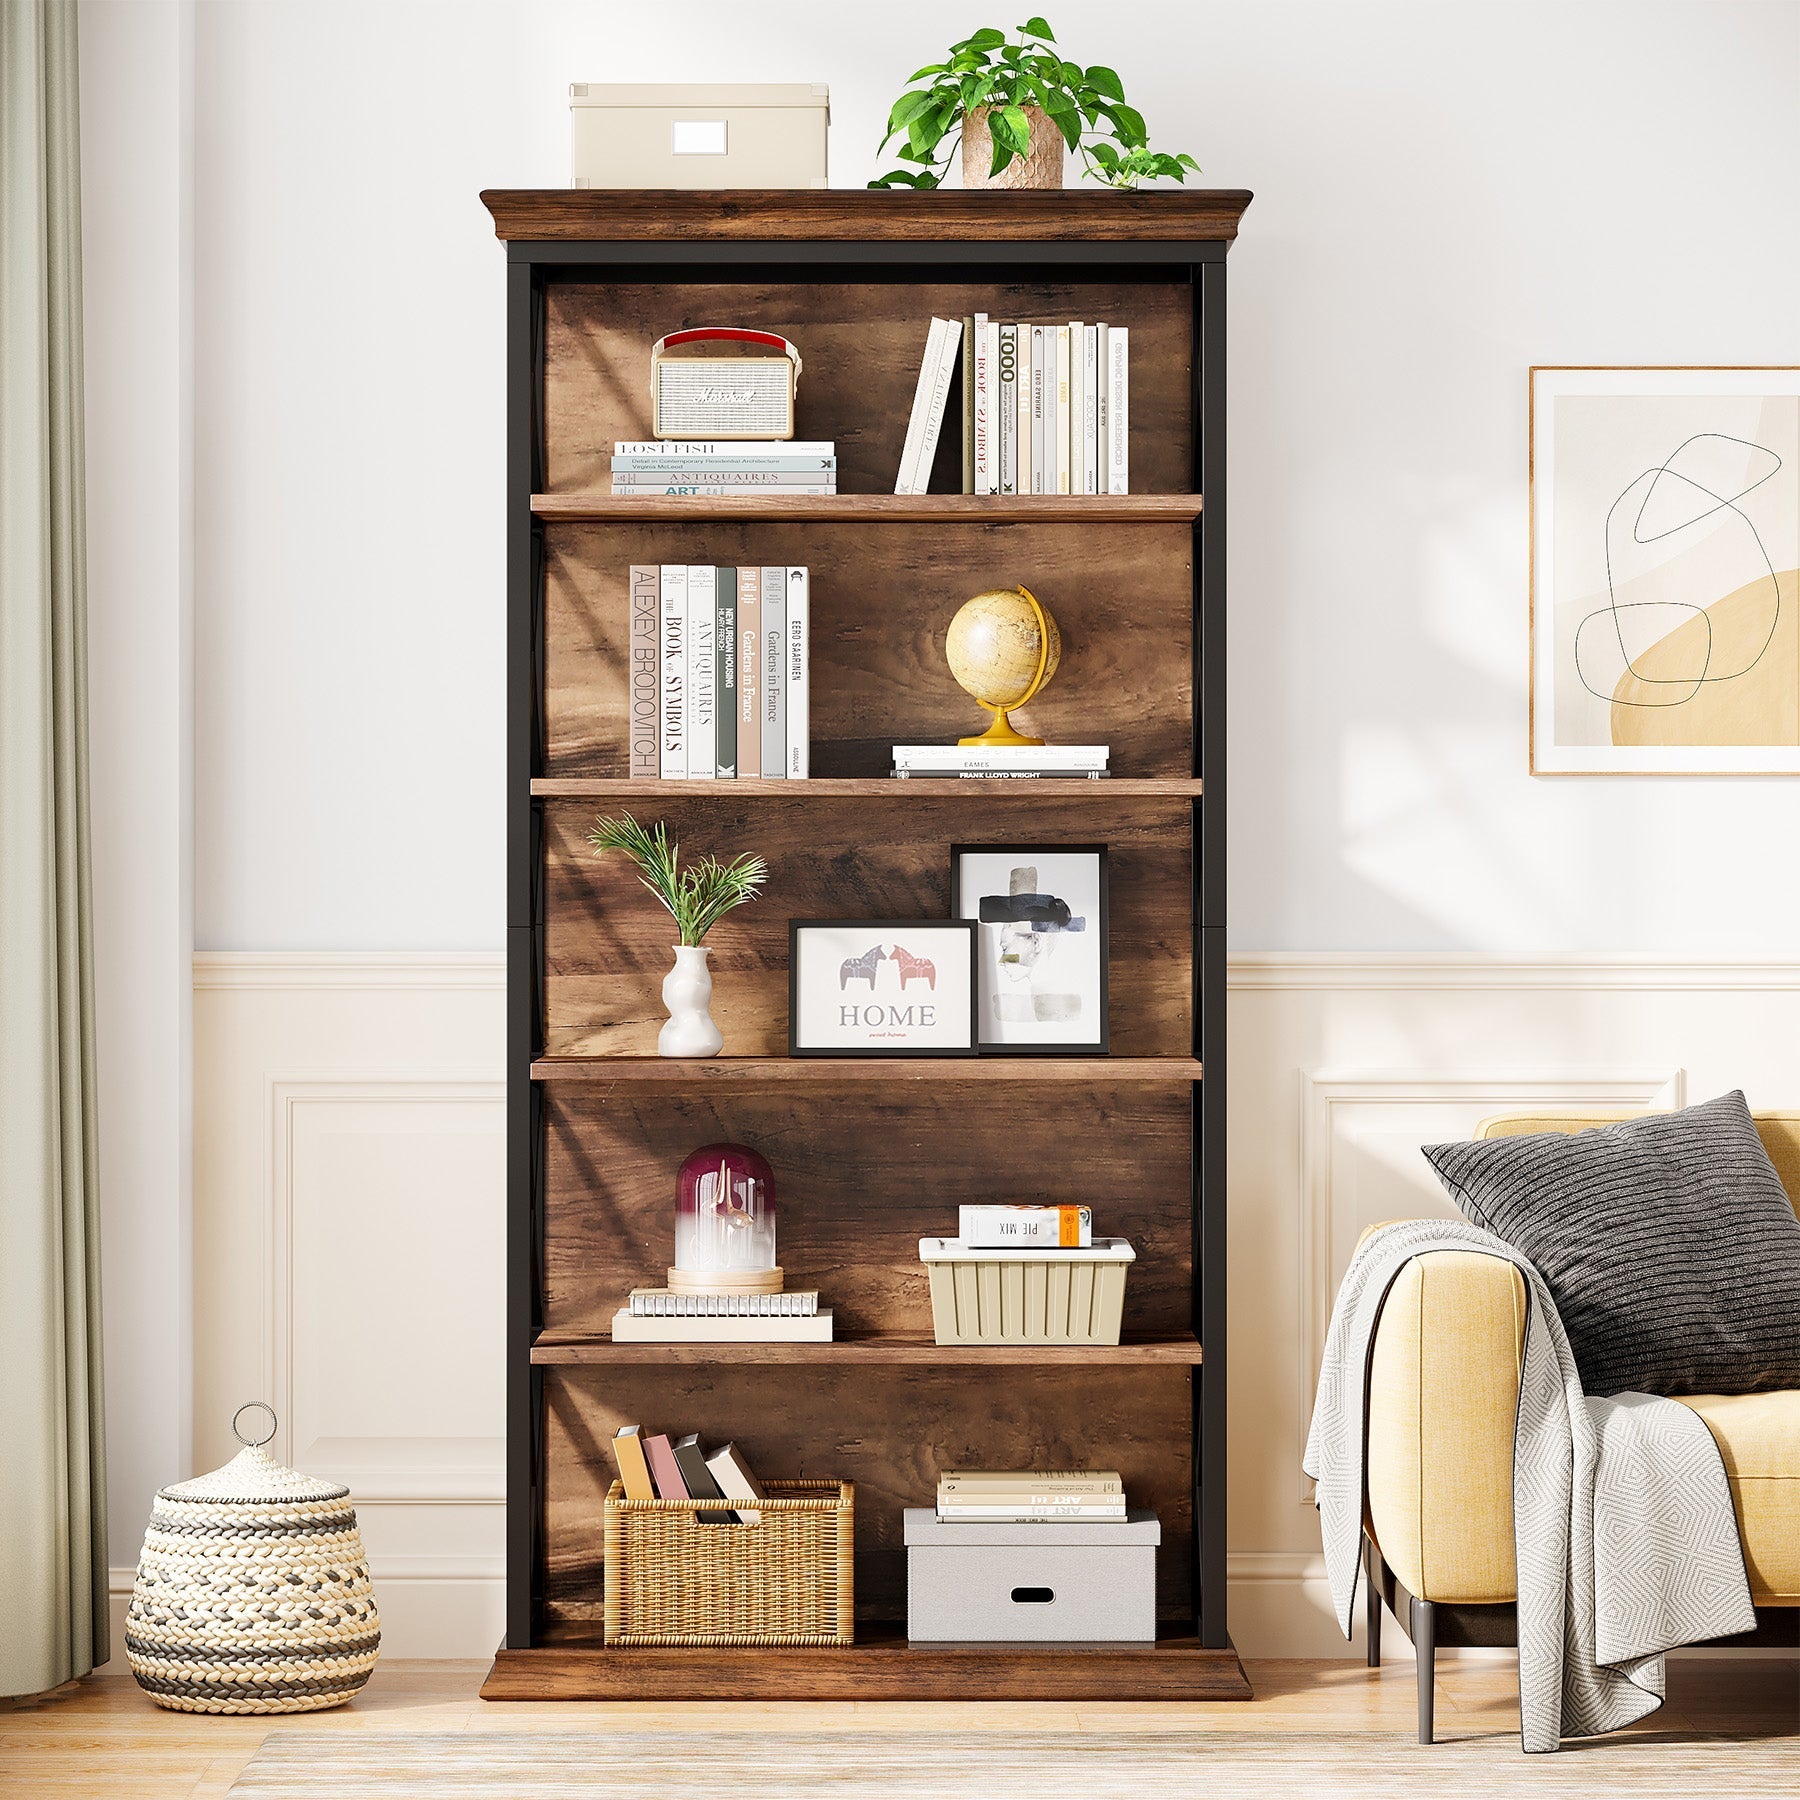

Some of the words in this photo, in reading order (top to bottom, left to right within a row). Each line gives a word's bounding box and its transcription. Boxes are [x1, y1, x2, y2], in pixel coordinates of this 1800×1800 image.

[620, 444, 670, 454] LOST
[674, 444, 715, 454] FISH
[658, 458, 704, 466] Contemporary
[670, 473, 779, 482] ANTIQUAIRES
[665, 486, 700, 495] ART
[634, 571, 656, 643] ALEXEY
[666, 598, 675, 613] THE
[725, 607, 734, 627] NEW
[665, 616, 682, 659] BOOK
[725, 627, 734, 653] URBAN
[791, 620, 801, 640] EERO
[743, 630, 756, 673] Gardens
[767, 630, 780, 673] Gardens
[791, 642, 801, 681] SAARINEN
[695, 620, 713, 726] ANTIQUAIRES
[725, 653, 734, 688] HOUSING
[743, 674, 755, 685] in
[768, 674, 780, 685] in
[634, 648, 656, 767] BRODOVITCH
[665, 676, 683, 752] SYMBOLS
[743, 687, 756, 722] France
[767, 687, 780, 722] France
[792, 747, 800, 773] ASSOULINE
[959, 771, 984, 779] FRANK
[984, 771, 1008, 779] LLOYD
[1009, 771, 1041, 779] WRIGHT
[839, 1005, 937, 1027] HOME
[999, 1223, 1017, 1235] MIX
[1023, 1223, 1038, 1235] PIE
[1050, 1496, 1082, 1505] ART
[1052, 1507, 1082, 1515] ART
